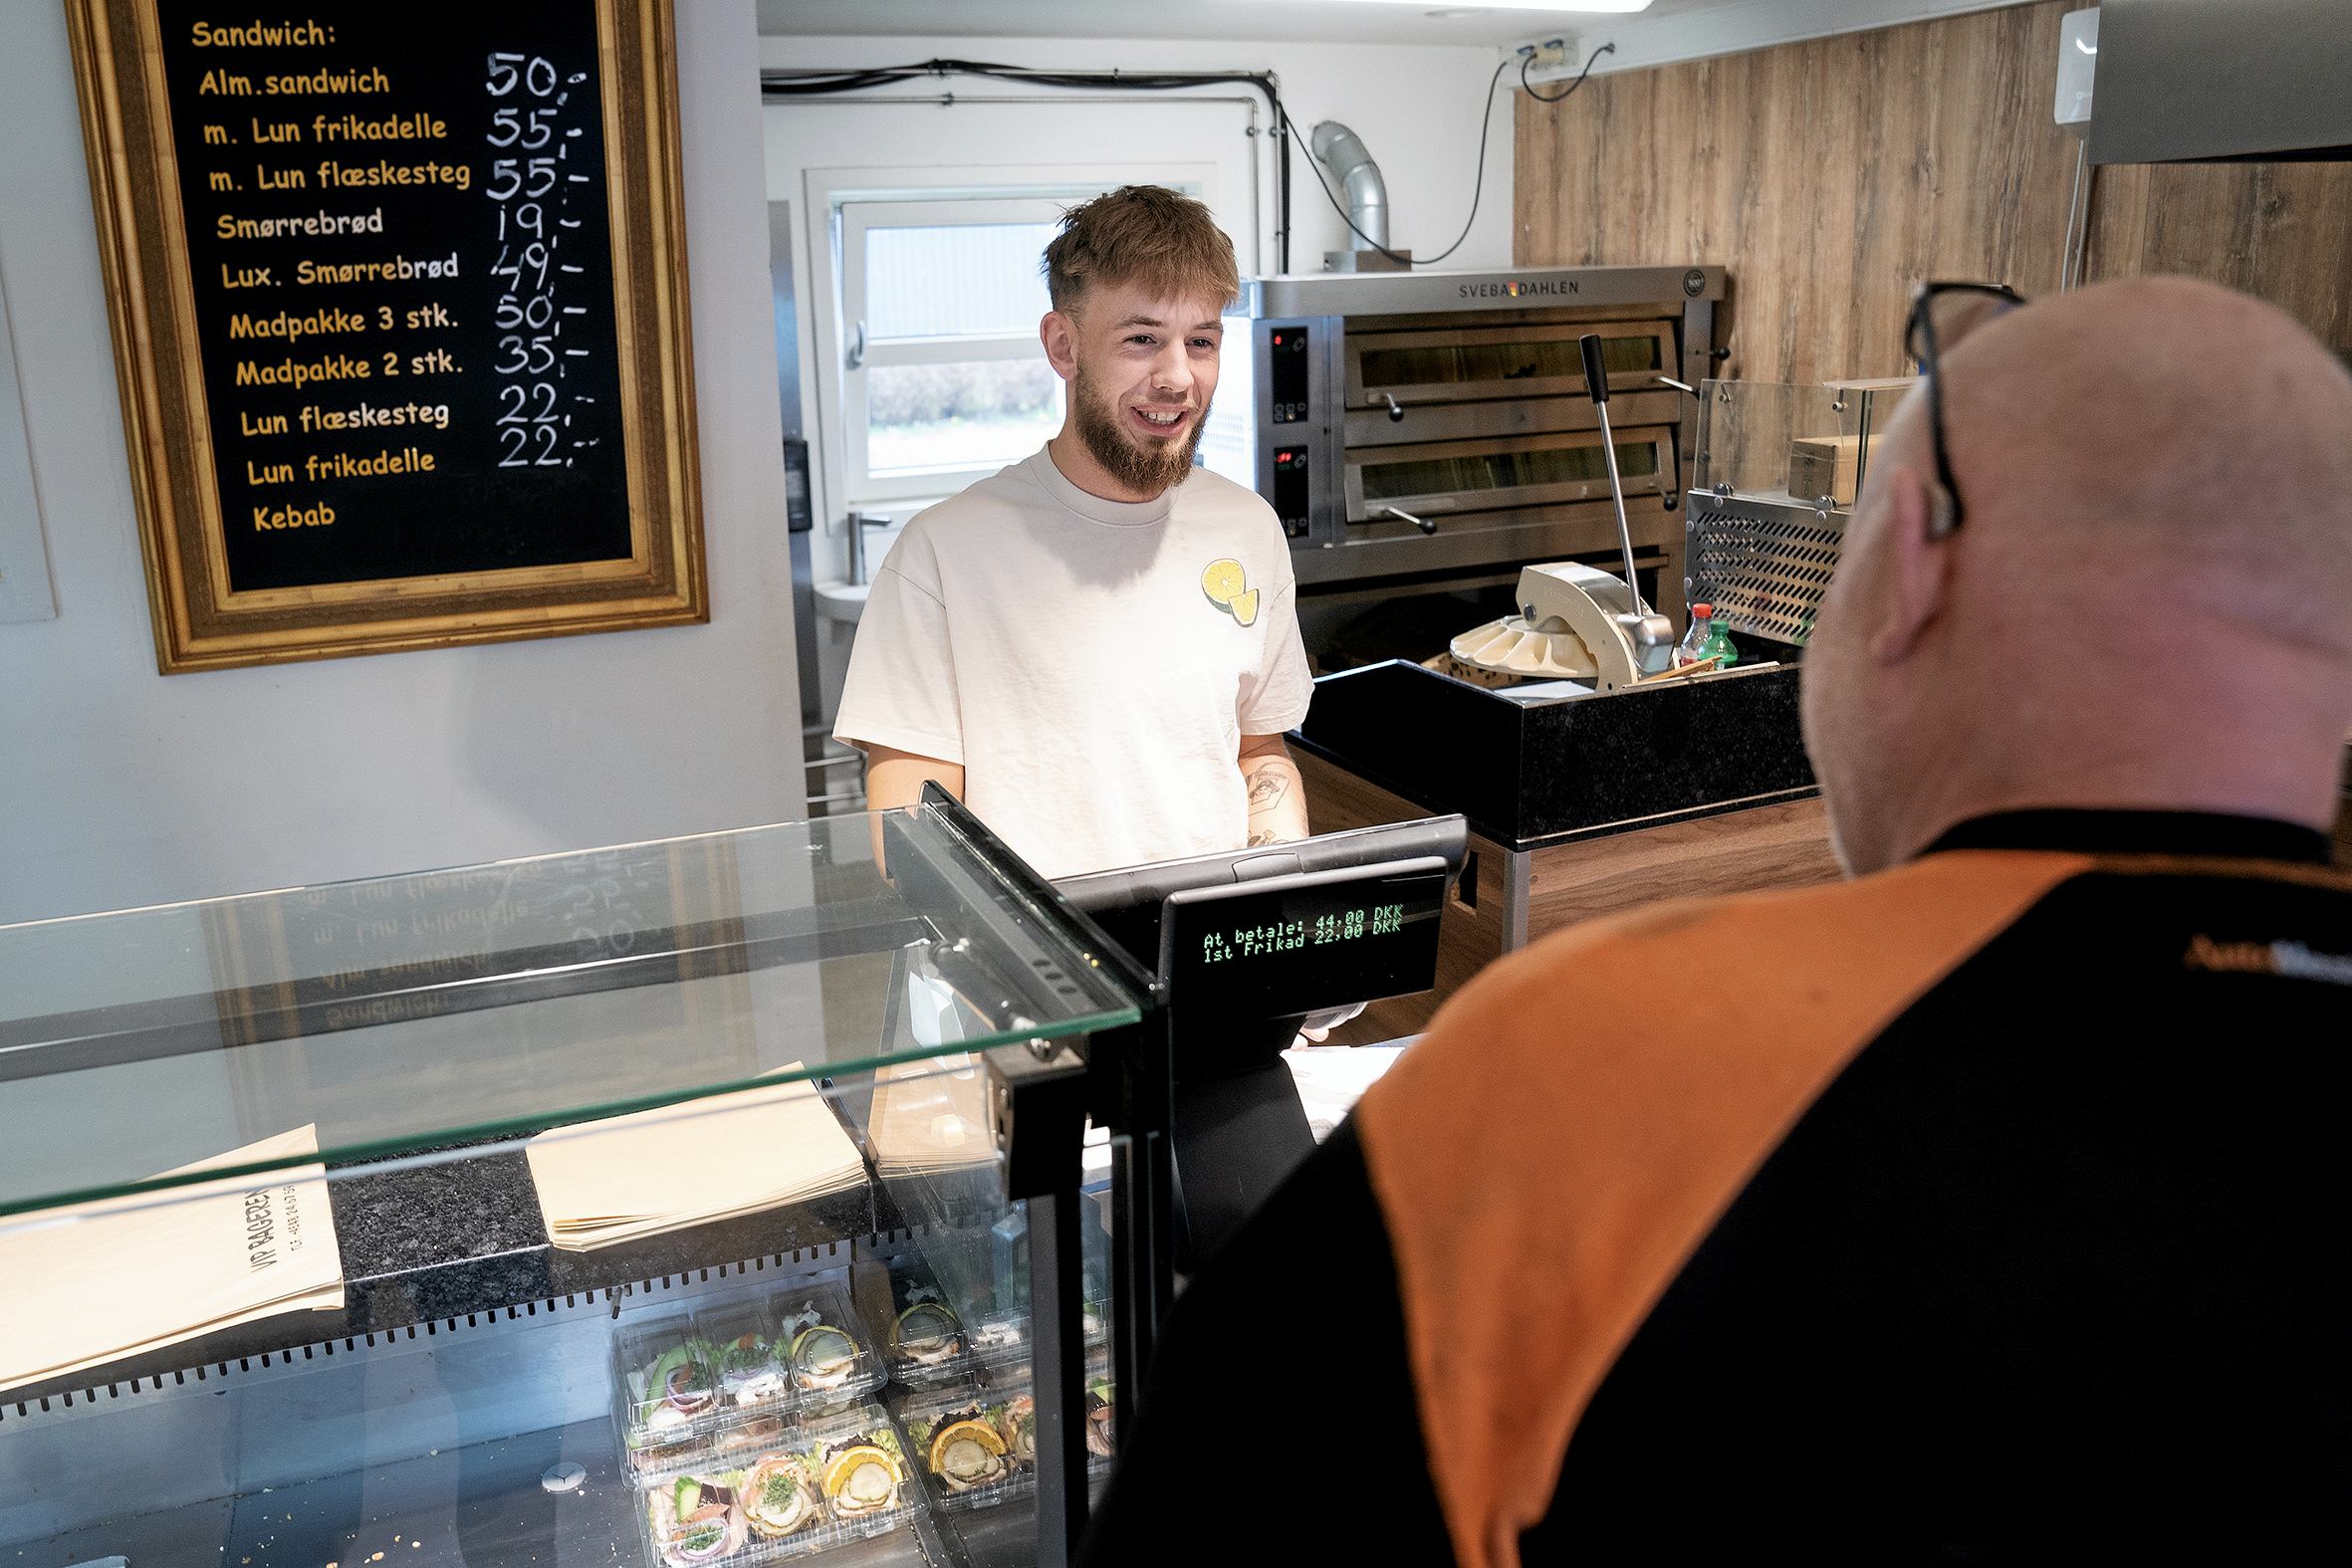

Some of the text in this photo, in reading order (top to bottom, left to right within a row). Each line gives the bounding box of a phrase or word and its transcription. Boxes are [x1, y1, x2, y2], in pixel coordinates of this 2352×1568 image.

[192, 20, 336, 47] Sandwich:
[200, 67, 390, 96] Alm.sandwich
[204, 113, 448, 144] m. Lun frikadelle
[210, 160, 471, 191] m. Lun flæskesteg
[217, 207, 383, 239] Smørrebrød
[222, 252, 459, 289] Lux. Smørrebrød
[1519, 281, 1579, 296] DAHLEN
[230, 303, 459, 342] Madpakke 3 stk.
[236, 348, 463, 389] Madpakke 2 stk.
[241, 402, 449, 436] Lun flæskesteg
[248, 447, 435, 485] Lun frikadelle
[254, 502, 336, 532] Kebab
[1204, 904, 1404, 949] At betale: 44,00 DKK
[1204, 918, 1403, 963] 1st Frikad 22,00 DKK
[245, 1189, 278, 1273] VIP BAGEREN
